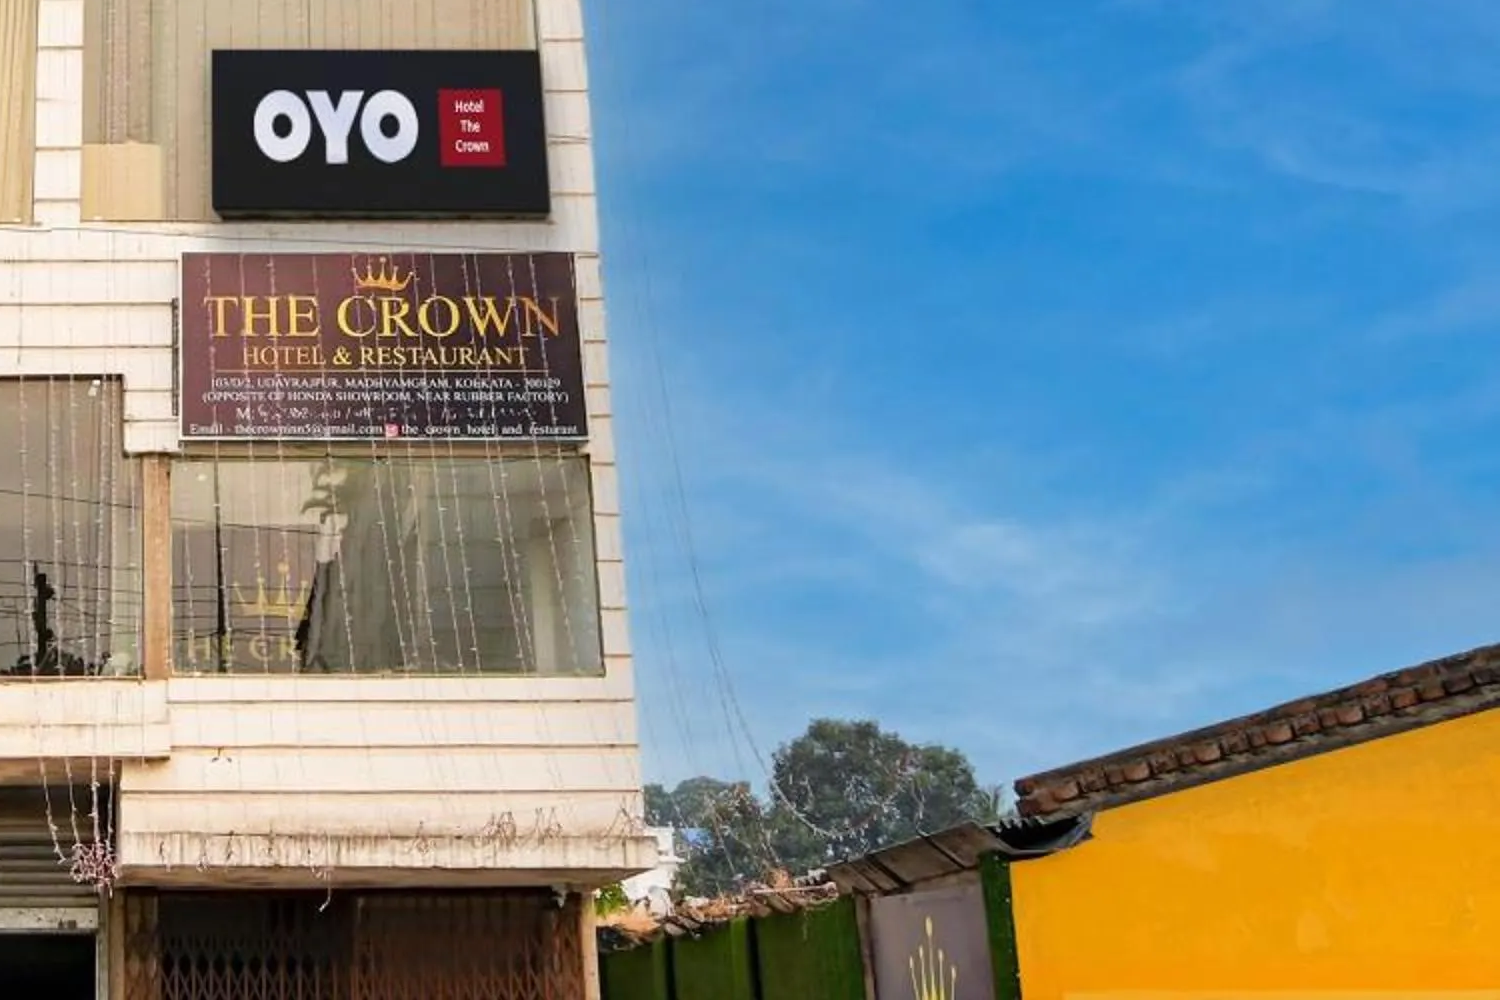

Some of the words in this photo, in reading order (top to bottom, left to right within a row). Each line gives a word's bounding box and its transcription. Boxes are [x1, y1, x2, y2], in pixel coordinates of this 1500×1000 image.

[455, 99, 484, 113] Hotel
[253, 89, 419, 165] OYO
[460, 119, 481, 133] The
[455, 139, 490, 153] Crown
[203, 294, 321, 338] THE
[337, 294, 561, 338] CROWN
[243, 346, 326, 366] HOTEL
[332, 346, 353, 366] &
[360, 346, 530, 367] RESTAURANT
[455, 377, 513, 389] KOLKATA
[202, 391, 267, 403] (OPPOSITE
[268, 391, 285, 401] OF
[288, 391, 333, 401] HONDA
[416, 391, 451, 401] NEAR
[453, 391, 504, 401] RUBBER
[507, 391, 570, 404] FACTORY)
